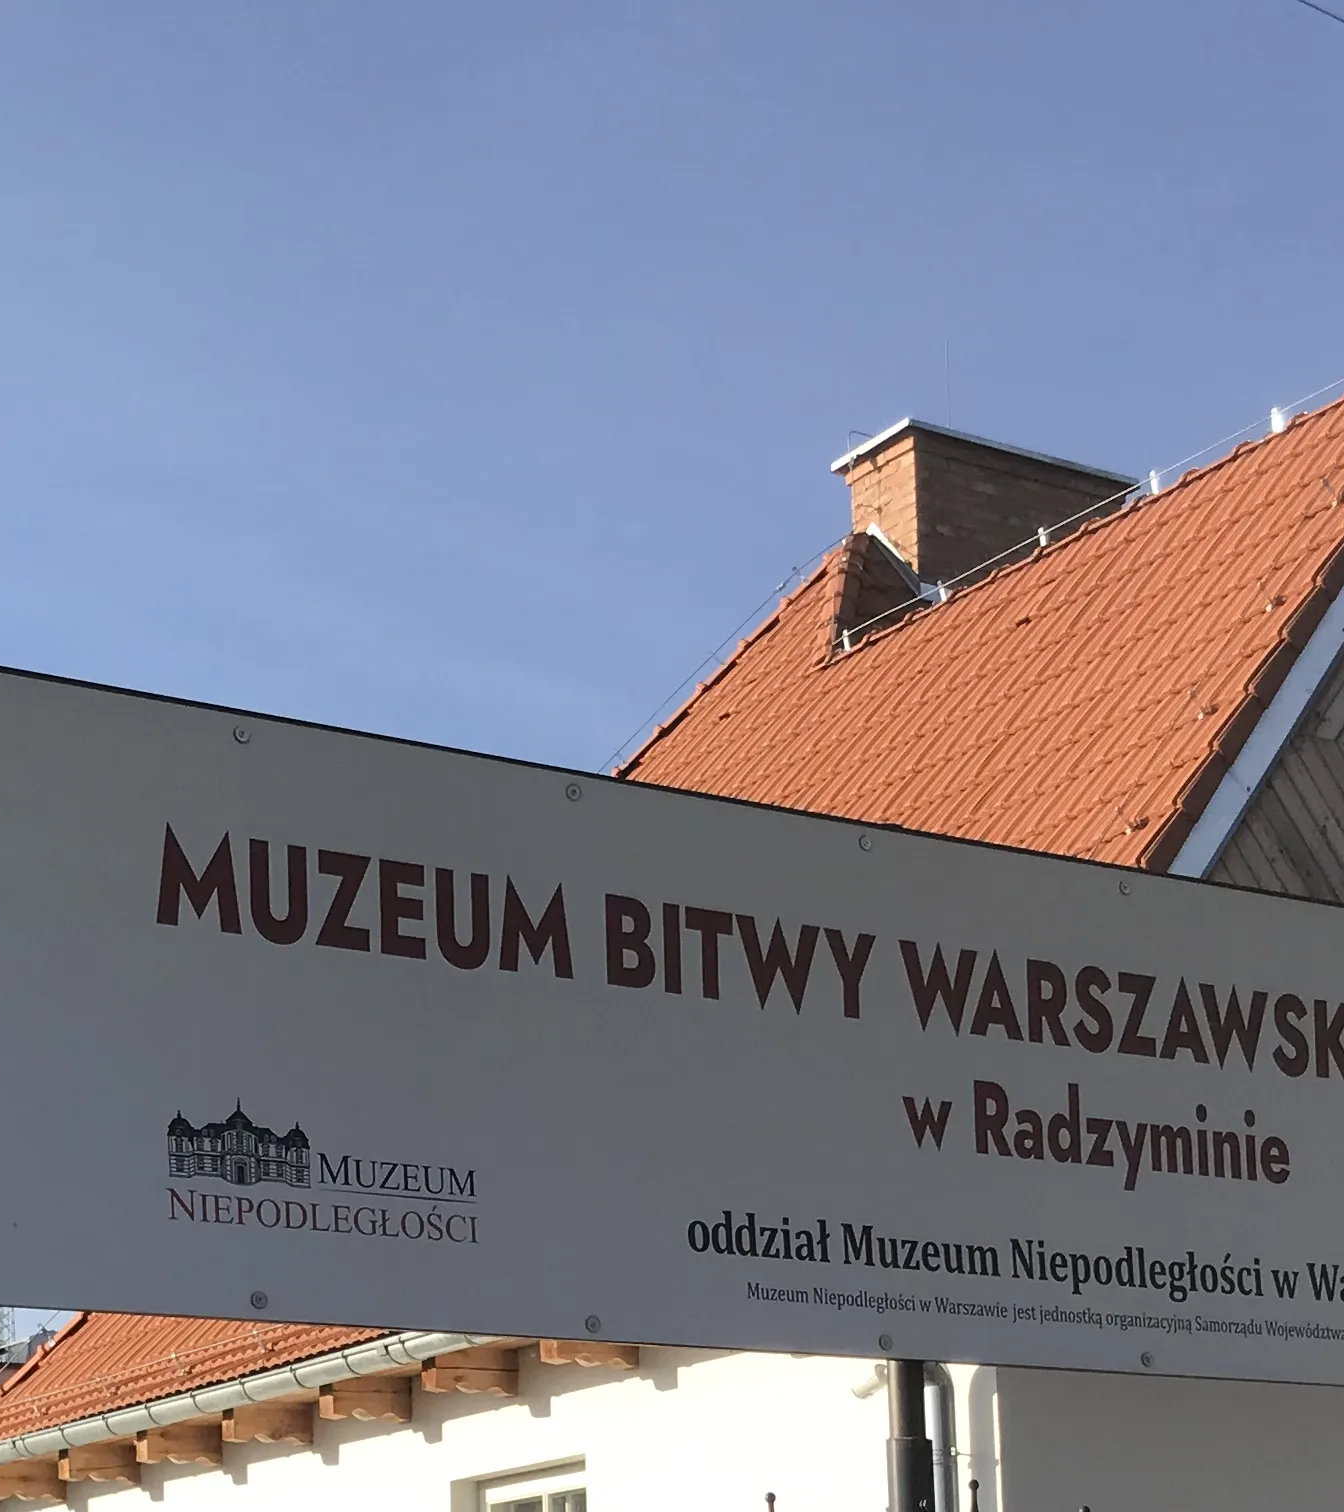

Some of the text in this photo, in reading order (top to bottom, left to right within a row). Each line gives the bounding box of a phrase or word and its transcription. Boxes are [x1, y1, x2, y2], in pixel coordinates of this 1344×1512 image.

[155, 821, 575, 980] MUZEUM
[605, 893, 877, 1020] BITWY
[903, 1080, 1290, 1191] w Radzyminie
[317, 1152, 477, 1197] MUZEUM
[166, 1187, 479, 1245] NIEPODLEGŁOŚCI
[687, 1210, 831, 1263] oddział
[841, 1222, 1001, 1278] Muzeum
[1010, 1238, 1263, 1302] Niepodległości
[1271, 1268, 1300, 1299] w
[747, 1282, 809, 1304] Muzeum
[813, 1286, 916, 1315] Niepodległości
[919, 1299, 932, 1312] w
[934, 1296, 1008, 1319] Warszawie
[1012, 1303, 1036, 1322] jest
[1039, 1305, 1103, 1329] jednostką
[1106, 1310, 1192, 1336] organizacyjną
[1195, 1316, 1262, 1340] Samorządu
